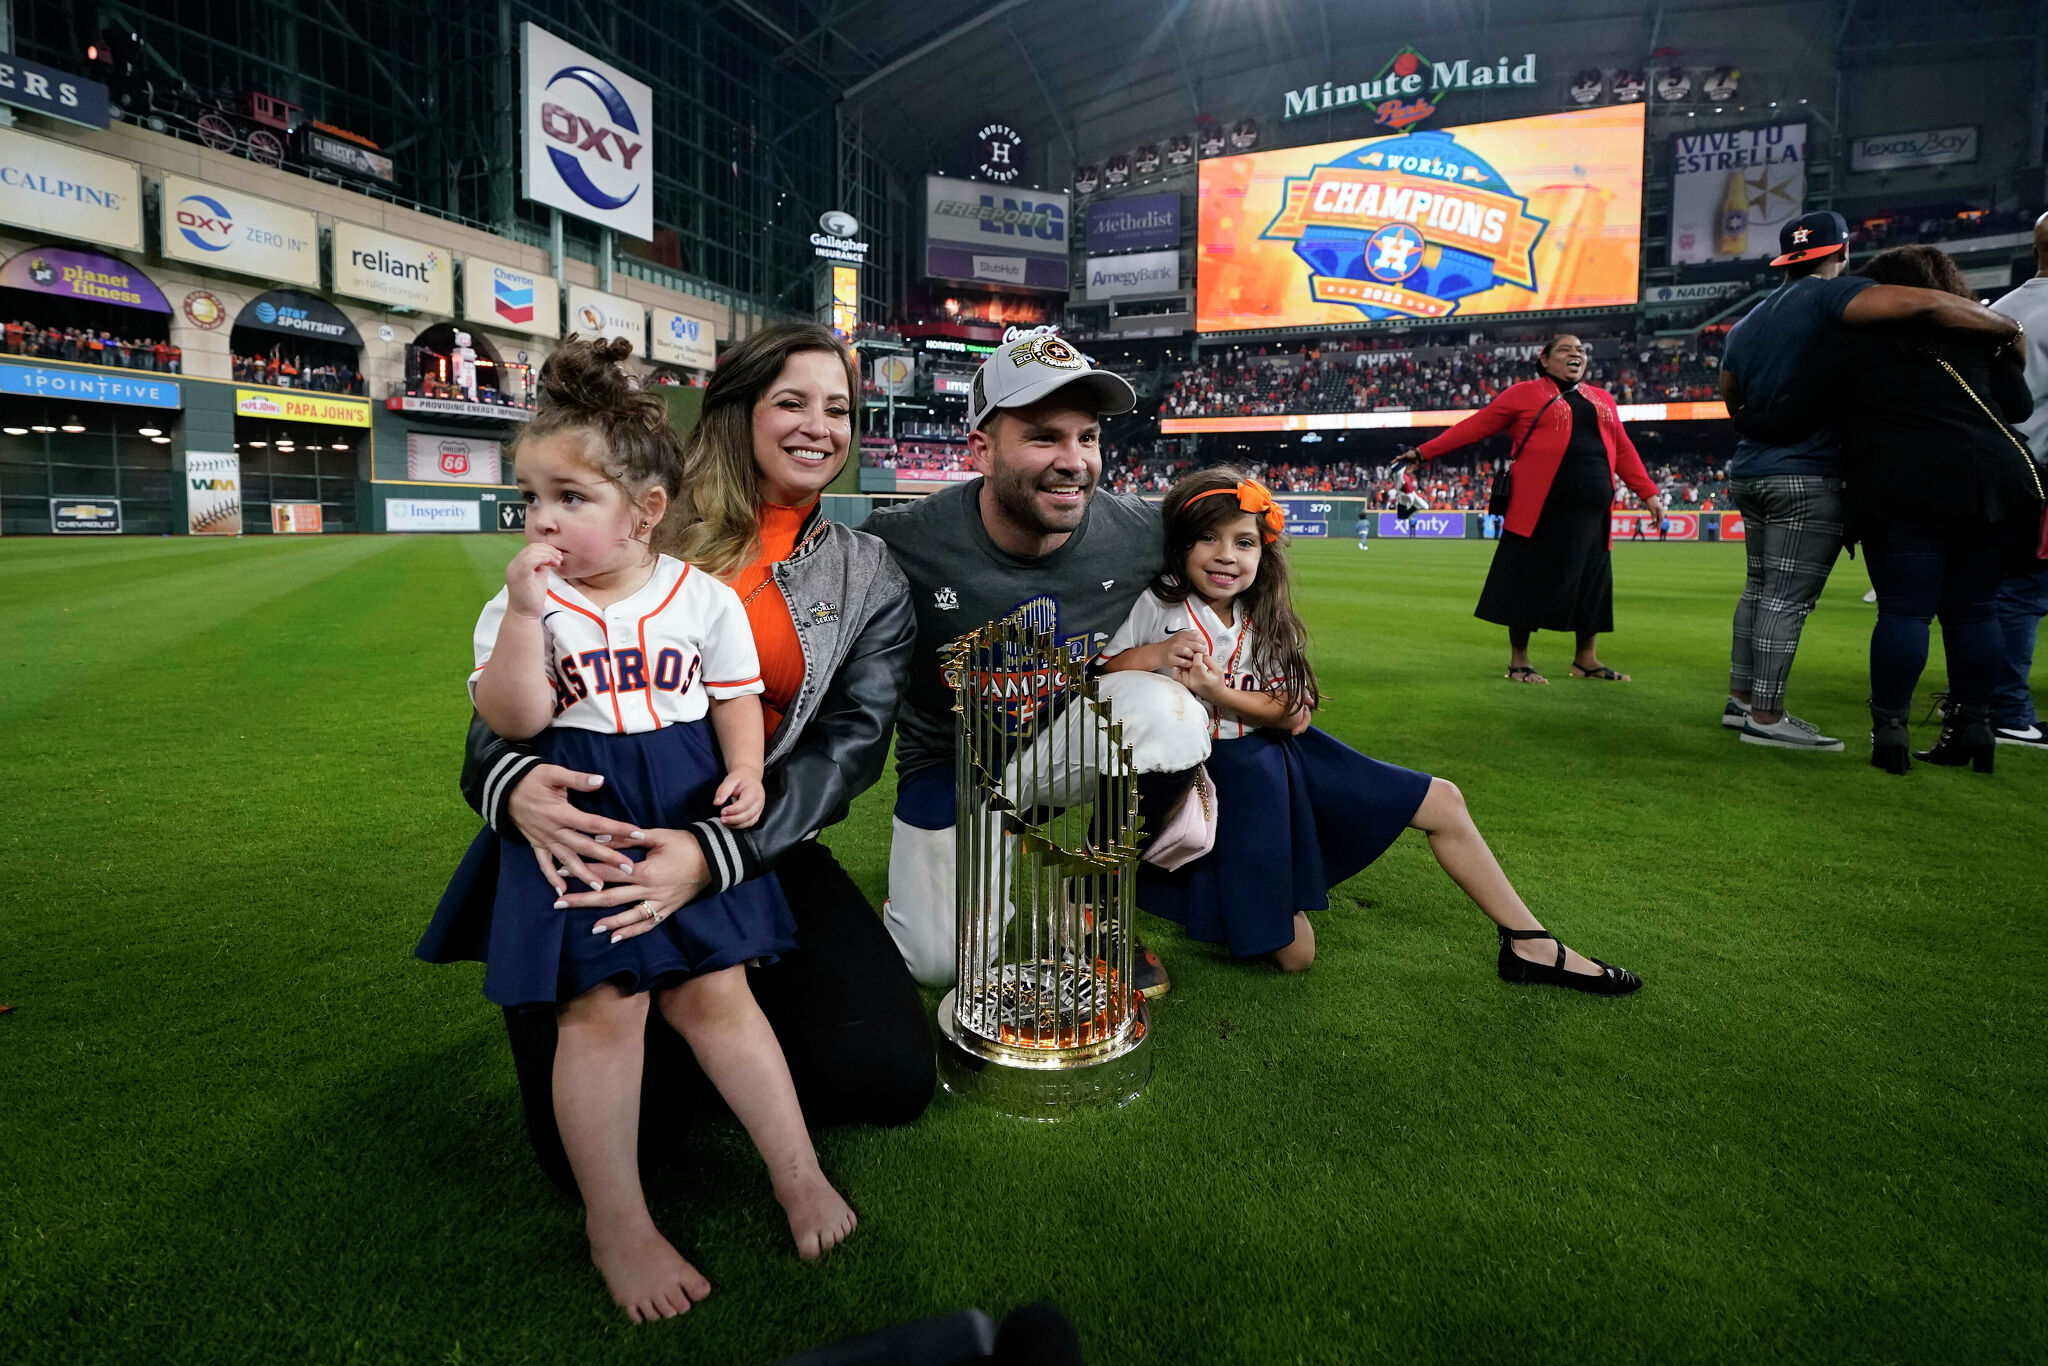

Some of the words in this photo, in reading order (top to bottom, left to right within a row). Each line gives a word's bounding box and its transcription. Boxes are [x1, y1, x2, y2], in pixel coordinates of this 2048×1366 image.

[1284, 72, 1422, 118] Minute
[1431, 53, 1537, 90] Maid
[1374, 97, 1436, 128] Park
[541, 102, 643, 171] OXY
[979, 124, 1021, 146] HOUSTON
[1860, 137, 1917, 158] Texas
[1924, 131, 1971, 153] Bay
[991, 141, 1011, 164] H
[980, 163, 1019, 181] ASTROS
[1387, 154, 1460, 178] WORLD
[1, 167, 120, 210] CALPINE
[936, 201, 1044, 227] FREEPORT
[1094, 210, 1174, 235] Methodist
[1312, 180, 1507, 244] CHAMPIONS
[176, 211, 233, 235] OXY
[246, 227, 282, 248] ZERO
[810, 233, 869, 253] Gallagher
[1791, 228, 1810, 245] H
[815, 247, 864, 263] INSURANCE
[1374, 235, 1415, 272] H
[63, 266, 129, 288] planet
[352, 249, 430, 284] reliant
[980, 262, 1020, 276] StubHub
[493, 268, 534, 287] Chevron
[72, 280, 142, 304] fitness
[1361, 287, 1403, 305] 2022
[277, 306, 308, 320] AT&T
[277, 315, 346, 336] SPORTSNET
[24, 374, 160, 399] 1POINTFIVE
[286, 401, 318, 417] PAPA
[321, 406, 364, 422] JOHN'S
[420, 401, 465, 412] PROVIDING
[443, 456, 465, 471] 66
[191, 478, 236, 491] WM
[411, 504, 467, 520] Insperity
[1310, 503, 1332, 513] 370
[57, 520, 117, 529] CHEVROLET
[809, 604, 836, 613] WORLD
[934, 592, 958, 604] WS
[815, 614, 839, 625] SERIES
